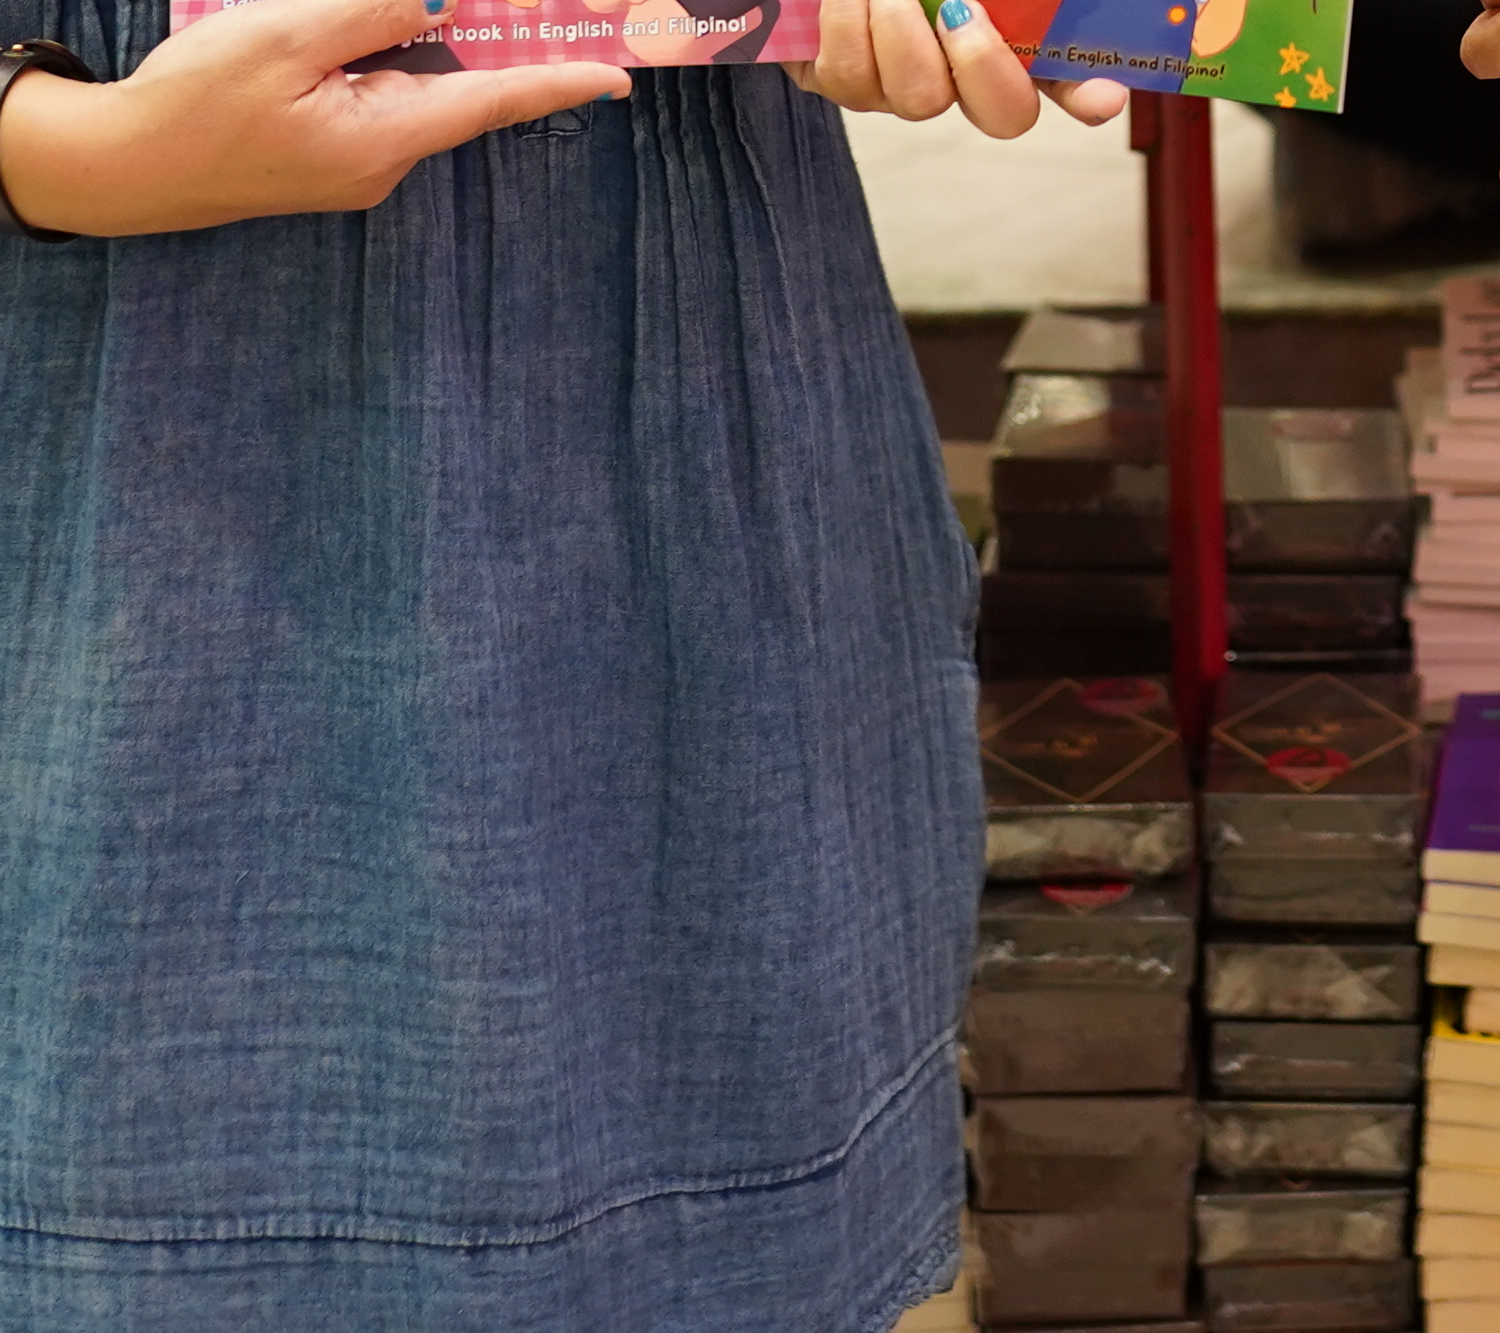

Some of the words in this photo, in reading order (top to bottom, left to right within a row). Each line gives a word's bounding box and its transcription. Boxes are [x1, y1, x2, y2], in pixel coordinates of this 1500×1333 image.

[452, 21, 504, 43] book
[512, 20, 531, 39] in
[538, 19, 615, 43] English
[622, 17, 660, 37] and
[667, 14, 748, 40] Filipino!
[1047, 45, 1061, 59] in
[1067, 46, 1123, 68] English
[1128, 57, 1159, 71] and
[1164, 57, 1226, 81] Filipino!
